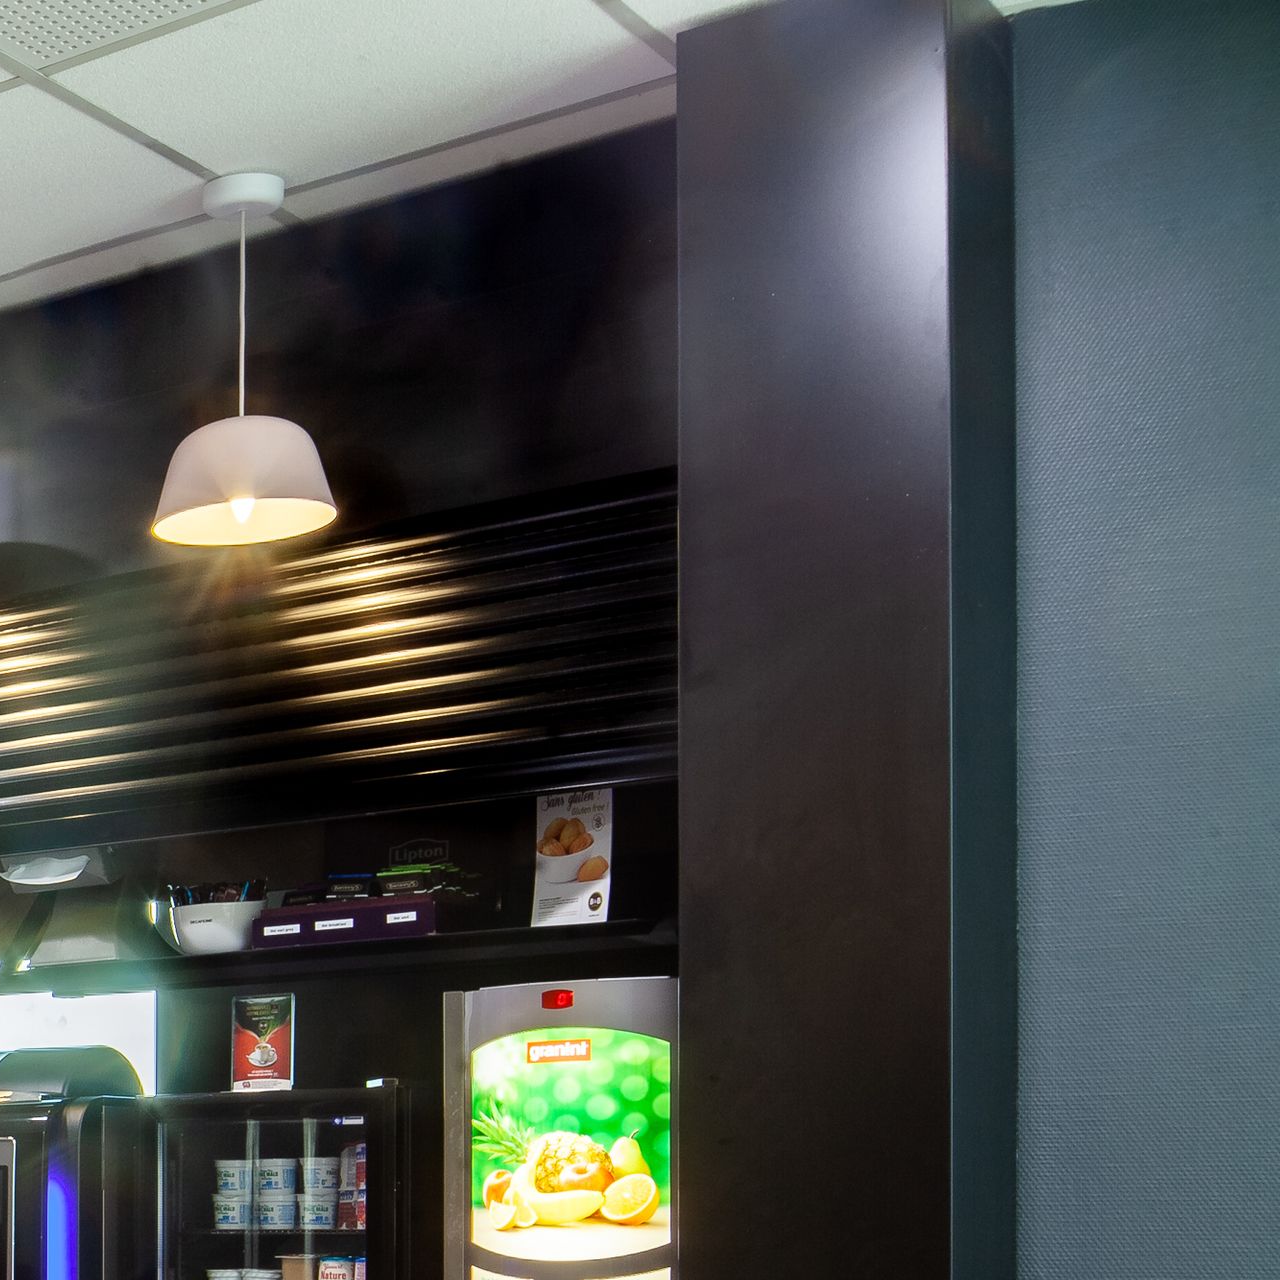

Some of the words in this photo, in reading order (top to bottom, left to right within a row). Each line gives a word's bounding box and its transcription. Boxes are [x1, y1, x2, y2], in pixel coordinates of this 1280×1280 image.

[395, 847, 444, 864] Lipton
[529, 1041, 589, 1062] granini
[320, 1270, 347, 1280] Nature
